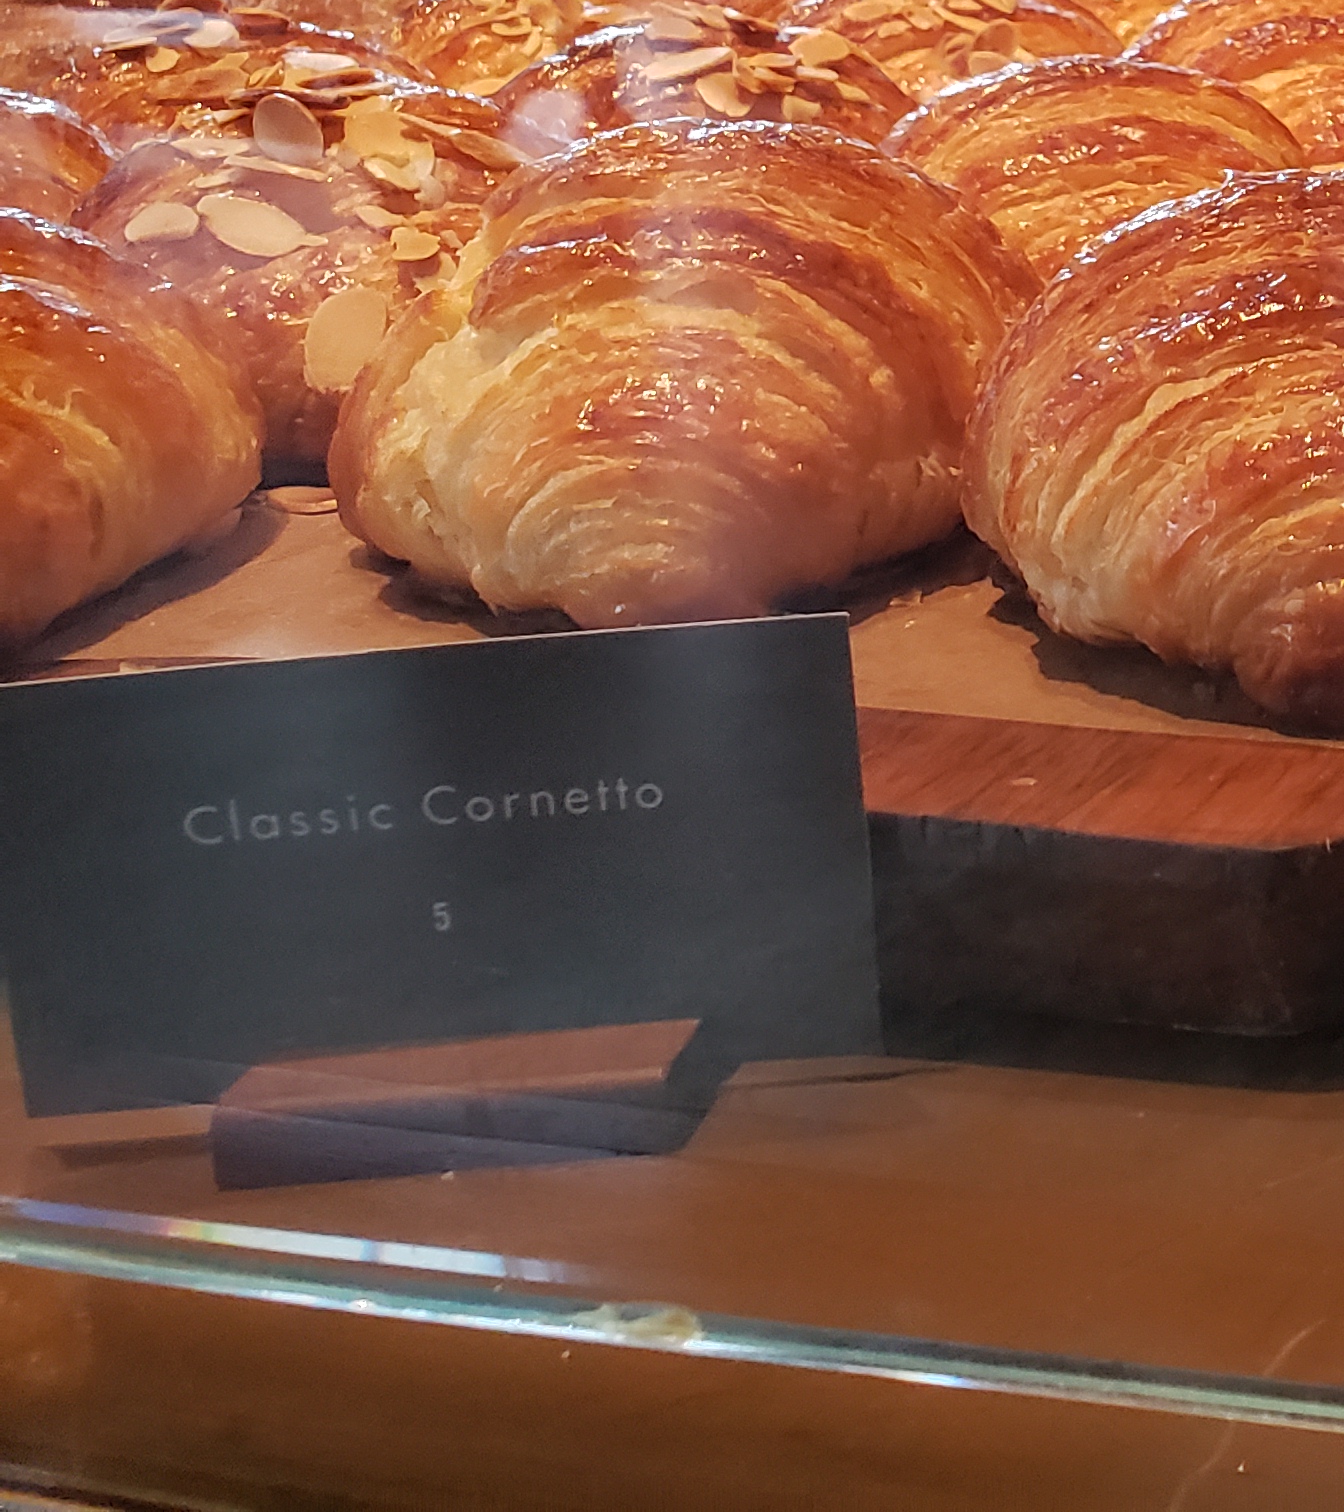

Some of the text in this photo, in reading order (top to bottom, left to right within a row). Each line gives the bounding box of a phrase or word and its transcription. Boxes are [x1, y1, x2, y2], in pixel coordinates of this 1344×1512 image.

[182, 777, 664, 846] Classic Cornetto
[432, 901, 452, 932] 5
